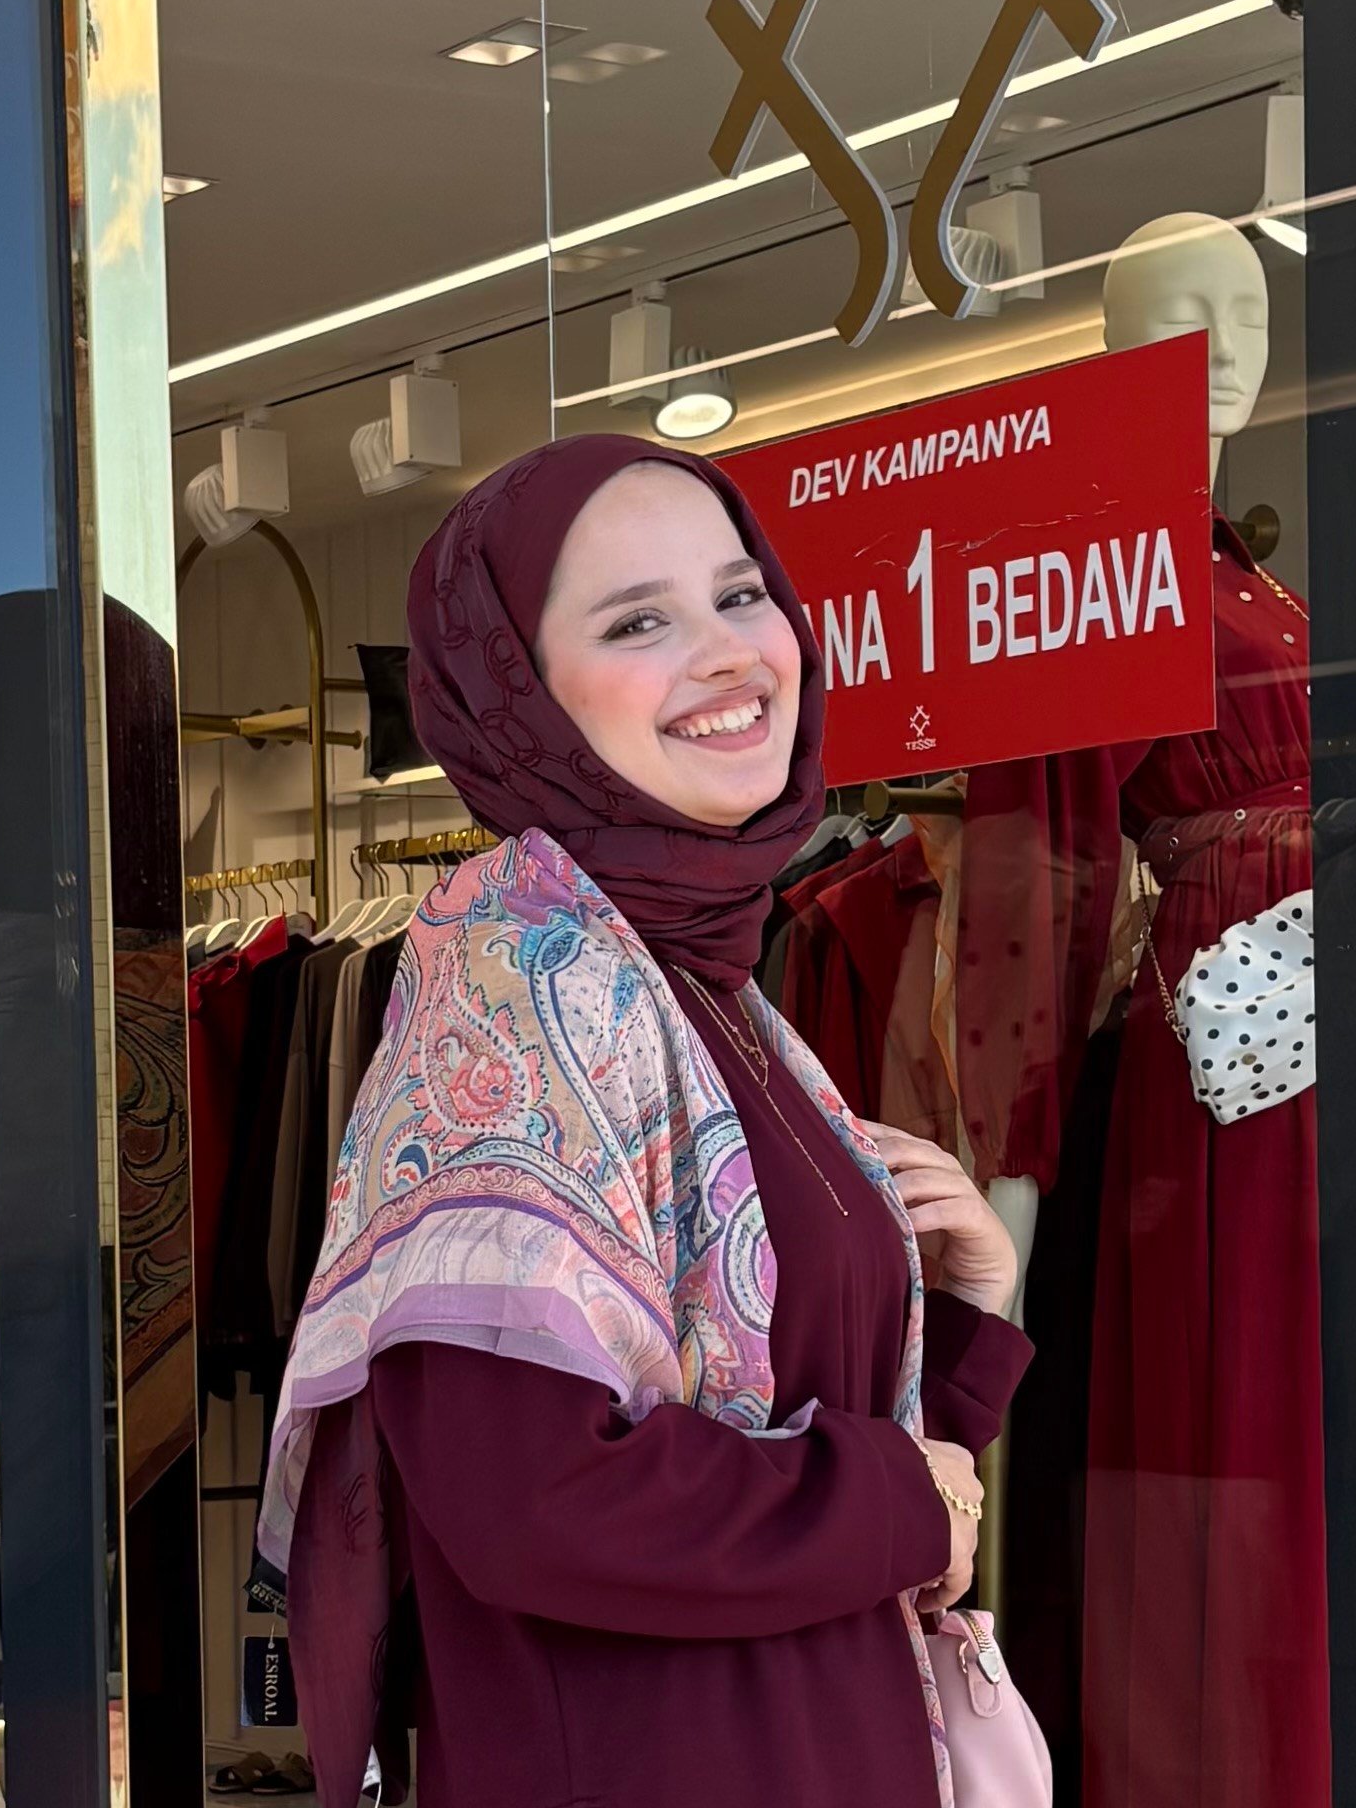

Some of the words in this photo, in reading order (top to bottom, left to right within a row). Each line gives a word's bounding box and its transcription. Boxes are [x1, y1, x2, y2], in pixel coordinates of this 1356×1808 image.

[789, 454, 857, 508] DEV
[862, 406, 1052, 491] KAMPANYA
[802, 590, 892, 691] NA
[907, 528, 934, 674] 1
[968, 528, 1185, 664] BEDAVA
